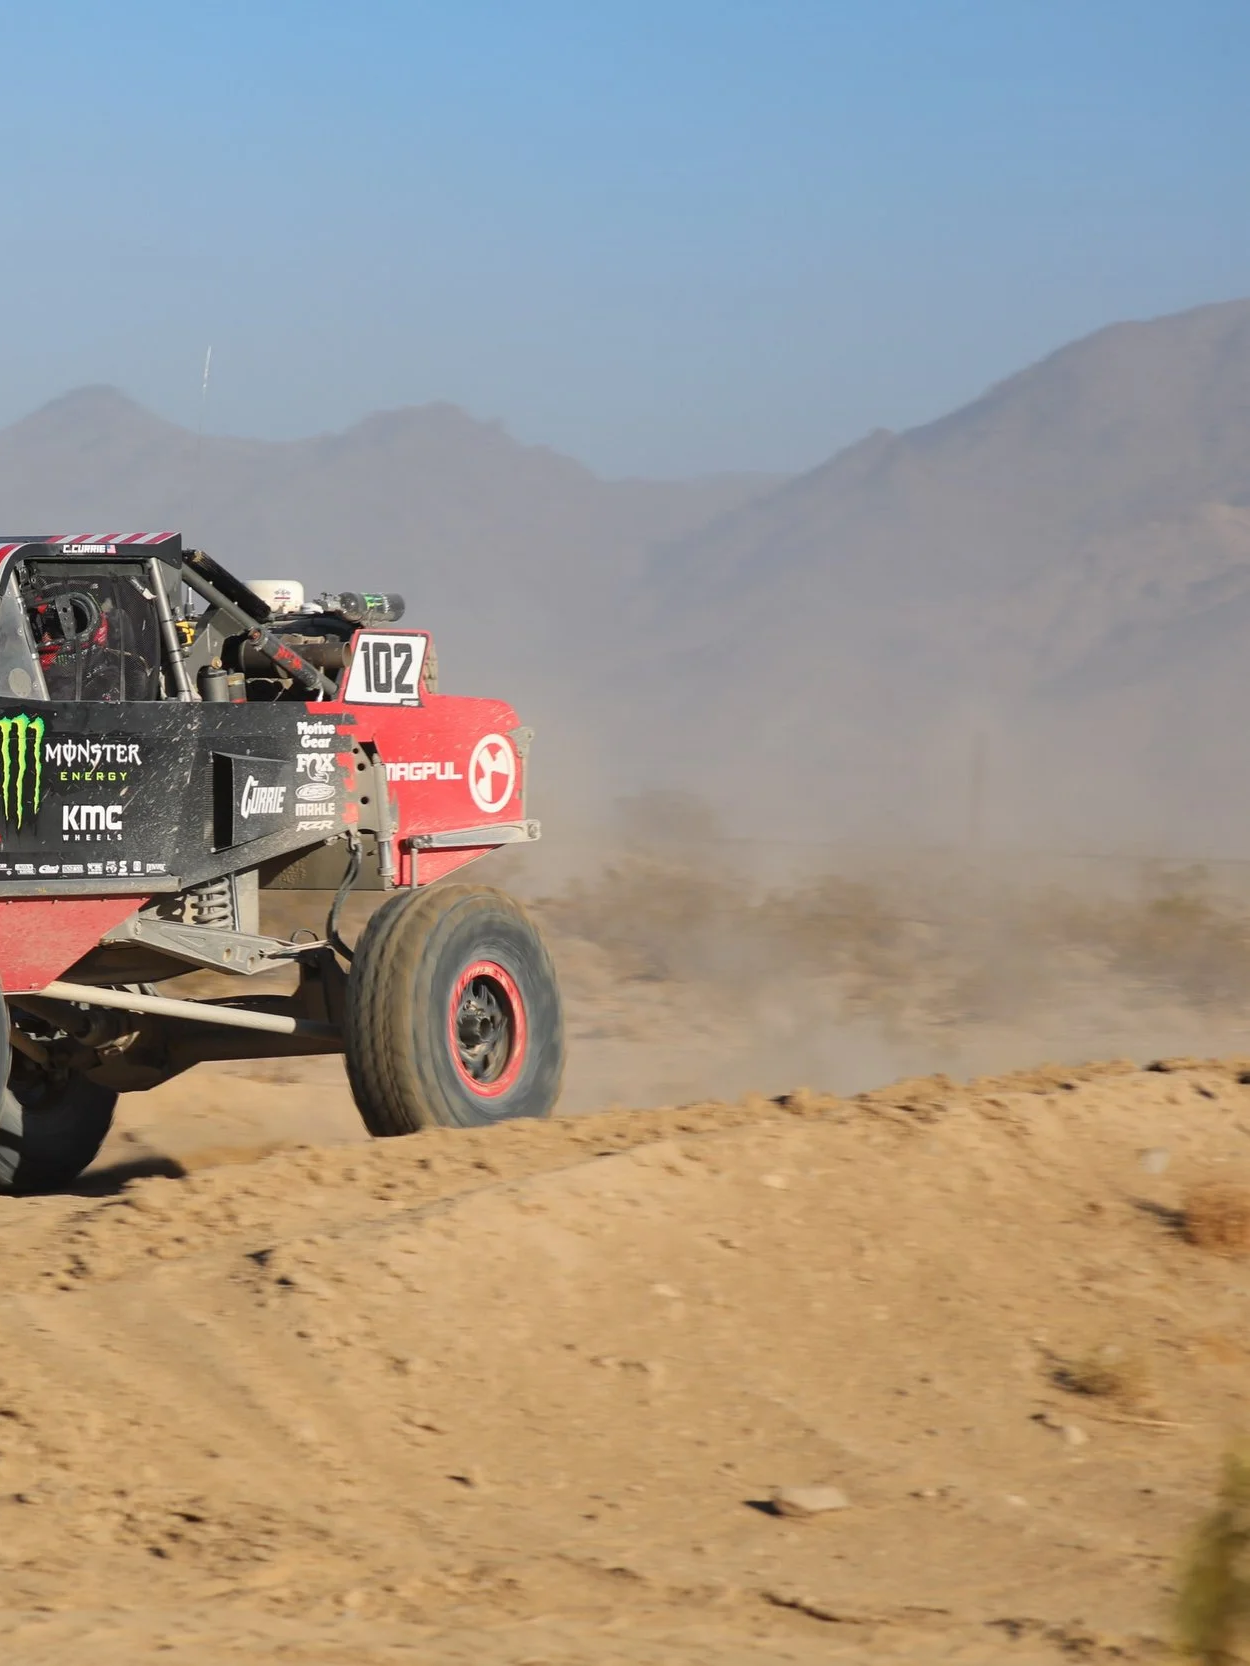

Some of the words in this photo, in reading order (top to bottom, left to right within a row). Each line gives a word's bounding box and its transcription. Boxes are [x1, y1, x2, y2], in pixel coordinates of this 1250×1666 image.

[361, 641, 414, 693] 102
[297, 721, 336, 735] Motive
[301, 735, 331, 748] Gear
[45, 739, 142, 767] MONSTER
[60, 771, 128, 781] ENERGY
[296, 753, 335, 782] FOX
[385, 761, 463, 781] MAGPUL
[62, 805, 123, 831] KMC
[295, 803, 335, 816] MAHLE
